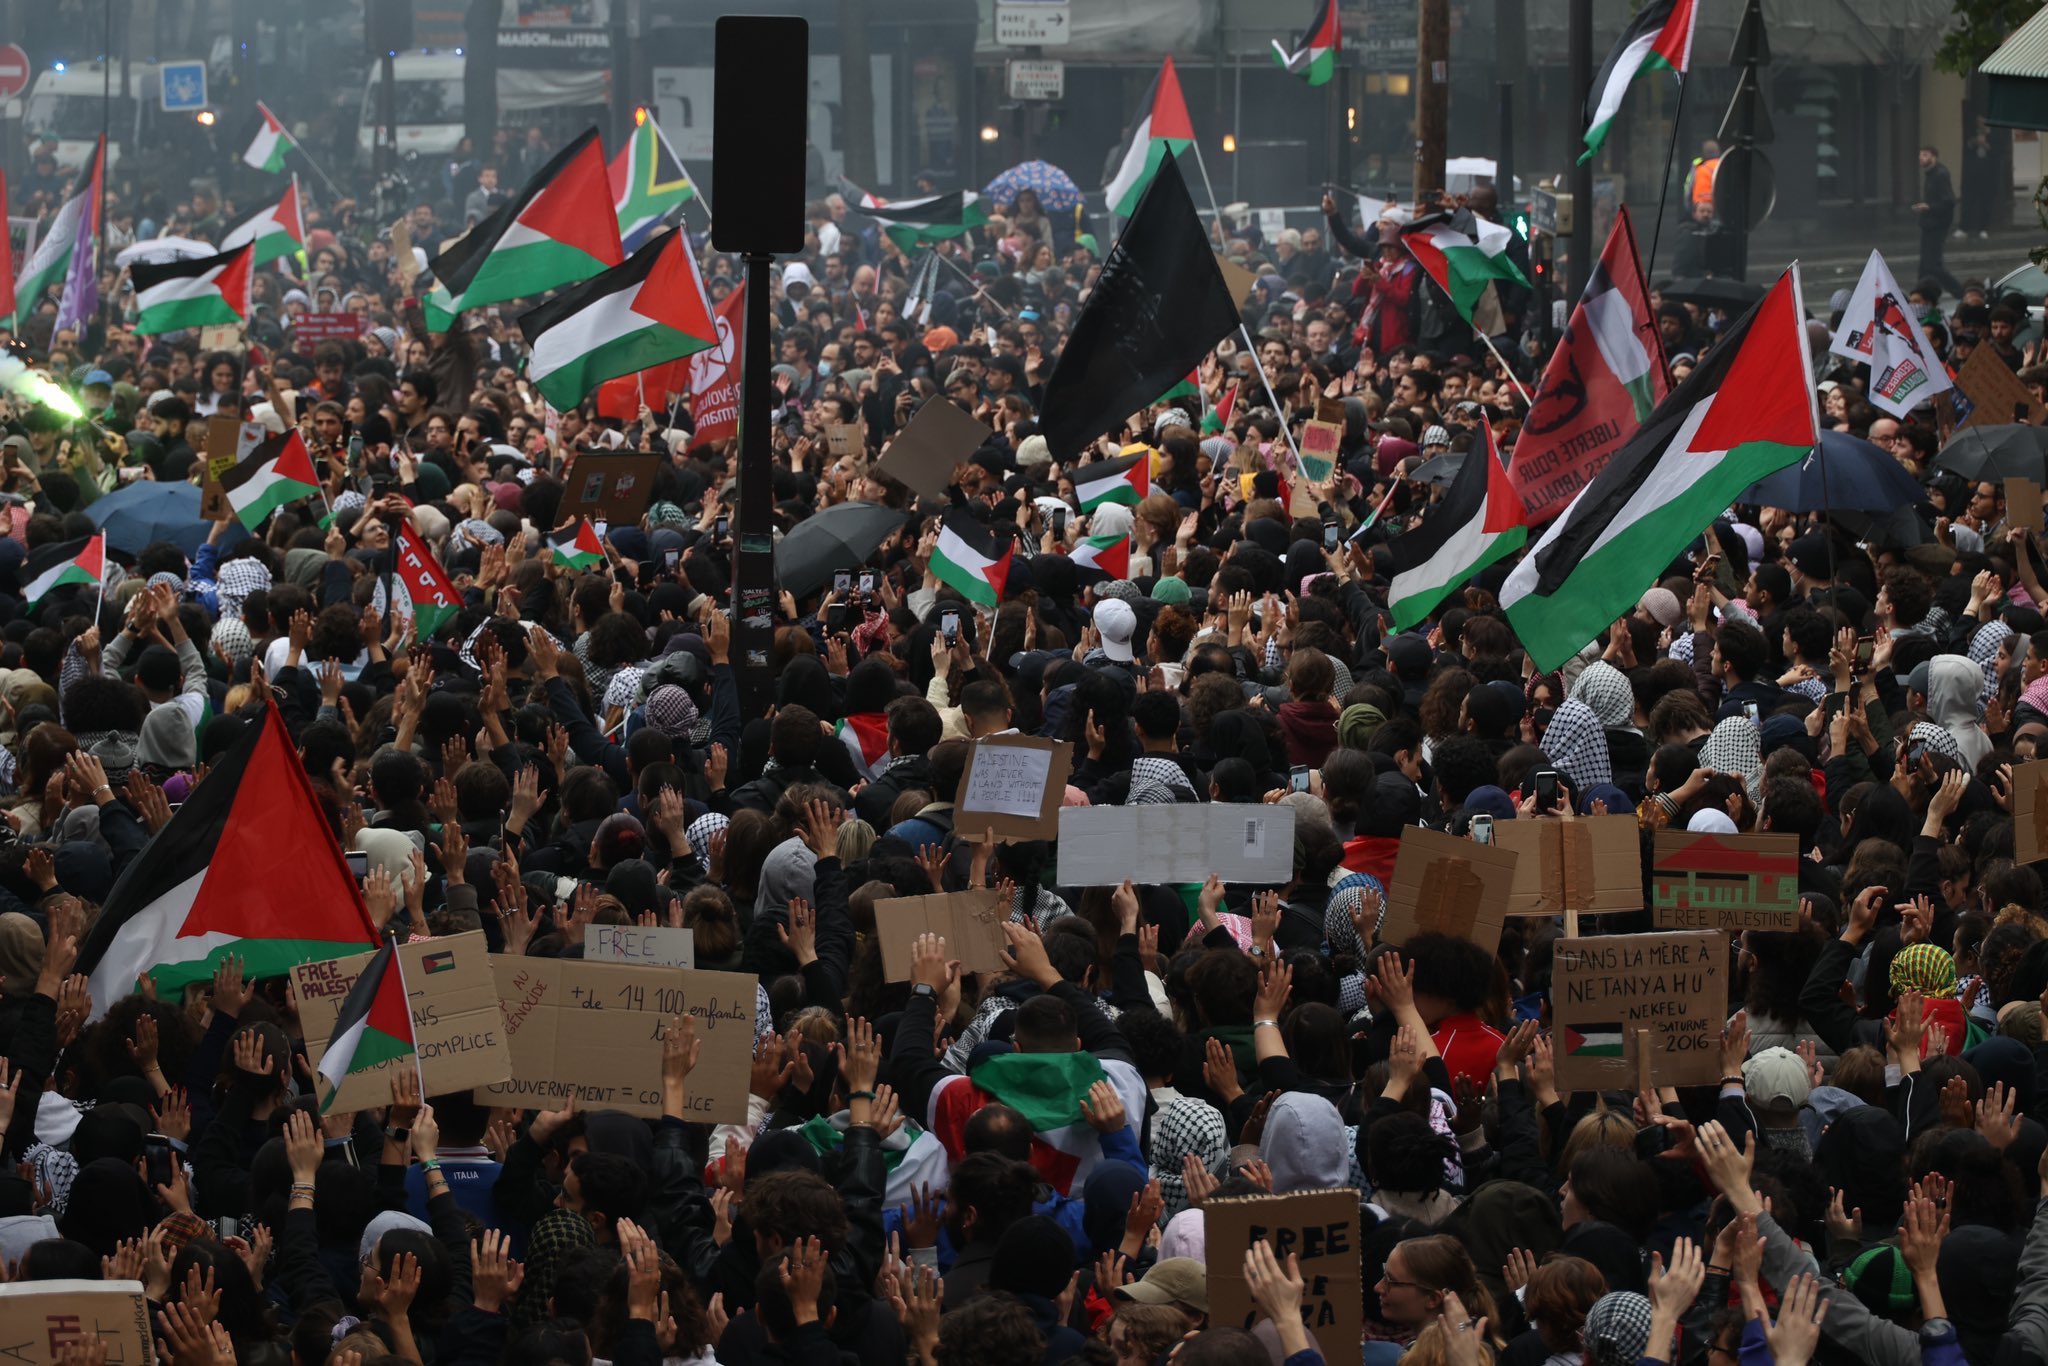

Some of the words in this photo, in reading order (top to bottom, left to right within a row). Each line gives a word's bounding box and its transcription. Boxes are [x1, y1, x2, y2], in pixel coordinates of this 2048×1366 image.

[977, 752, 1029, 767] PALESTINE
[974, 768, 990, 779] WAS
[996, 768, 1024, 779] NEVER
[978, 780, 1003, 790] LAND
[1008, 780, 1042, 789] WITHOUT
[982, 790, 1012, 802] PEOPLE
[1659, 909, 1710, 926] FREE
[1717, 910, 1792, 927] PALESTINE
[598, 929, 657, 957] FREE
[1624, 948, 1643, 968] LA
[1650, 941, 1690, 966] MÈRE
[1698, 939, 1710, 962] À
[296, 960, 342, 982] FREE
[512, 969, 529, 992] AU
[301, 973, 359, 1000] PALEST
[688, 997, 746, 1030] enfants
[1665, 1034, 1710, 1052] 2016
[453, 1170, 480, 1180] ITALIA
[1249, 1222, 1350, 1261] FREE
